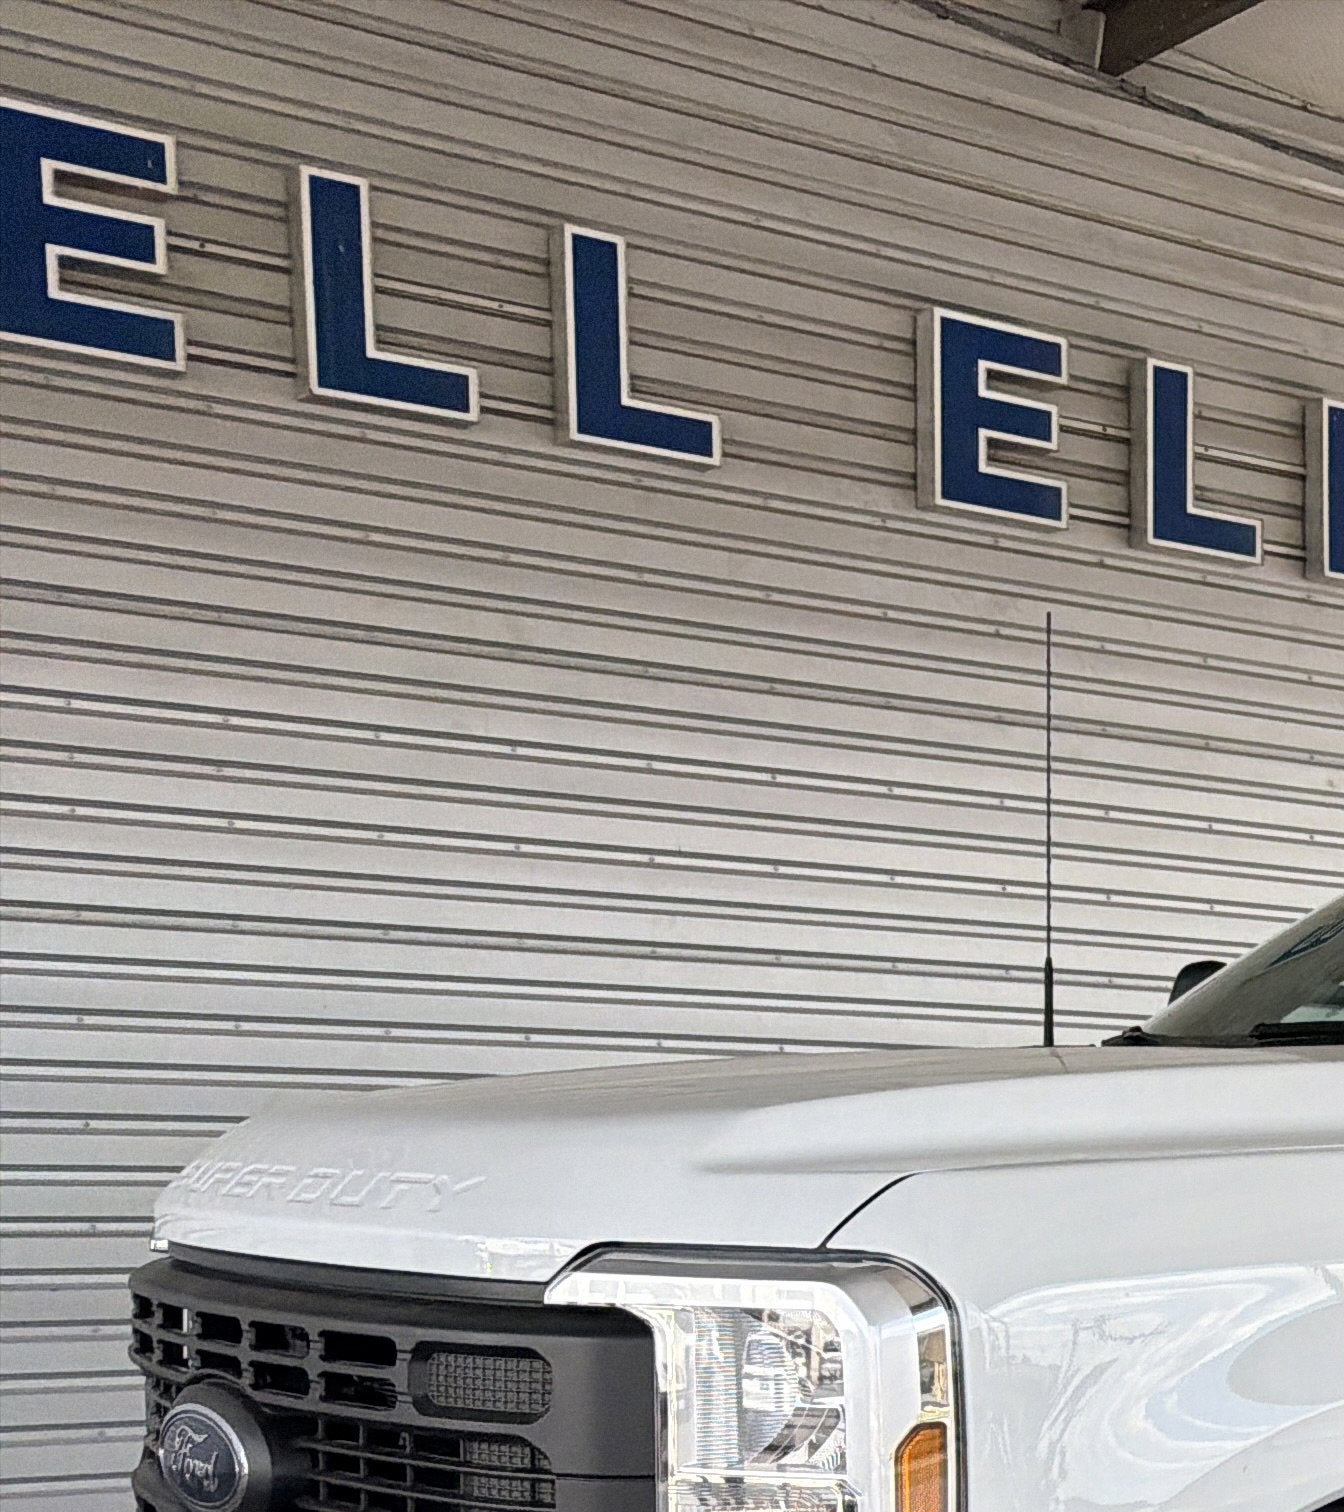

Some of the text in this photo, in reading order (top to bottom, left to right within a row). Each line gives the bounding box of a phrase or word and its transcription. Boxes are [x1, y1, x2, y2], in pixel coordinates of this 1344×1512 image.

[0, 100, 722, 467] ELL
[288, 1162, 488, 1213] DUTY
[171, 1424, 219, 1493] Ford
